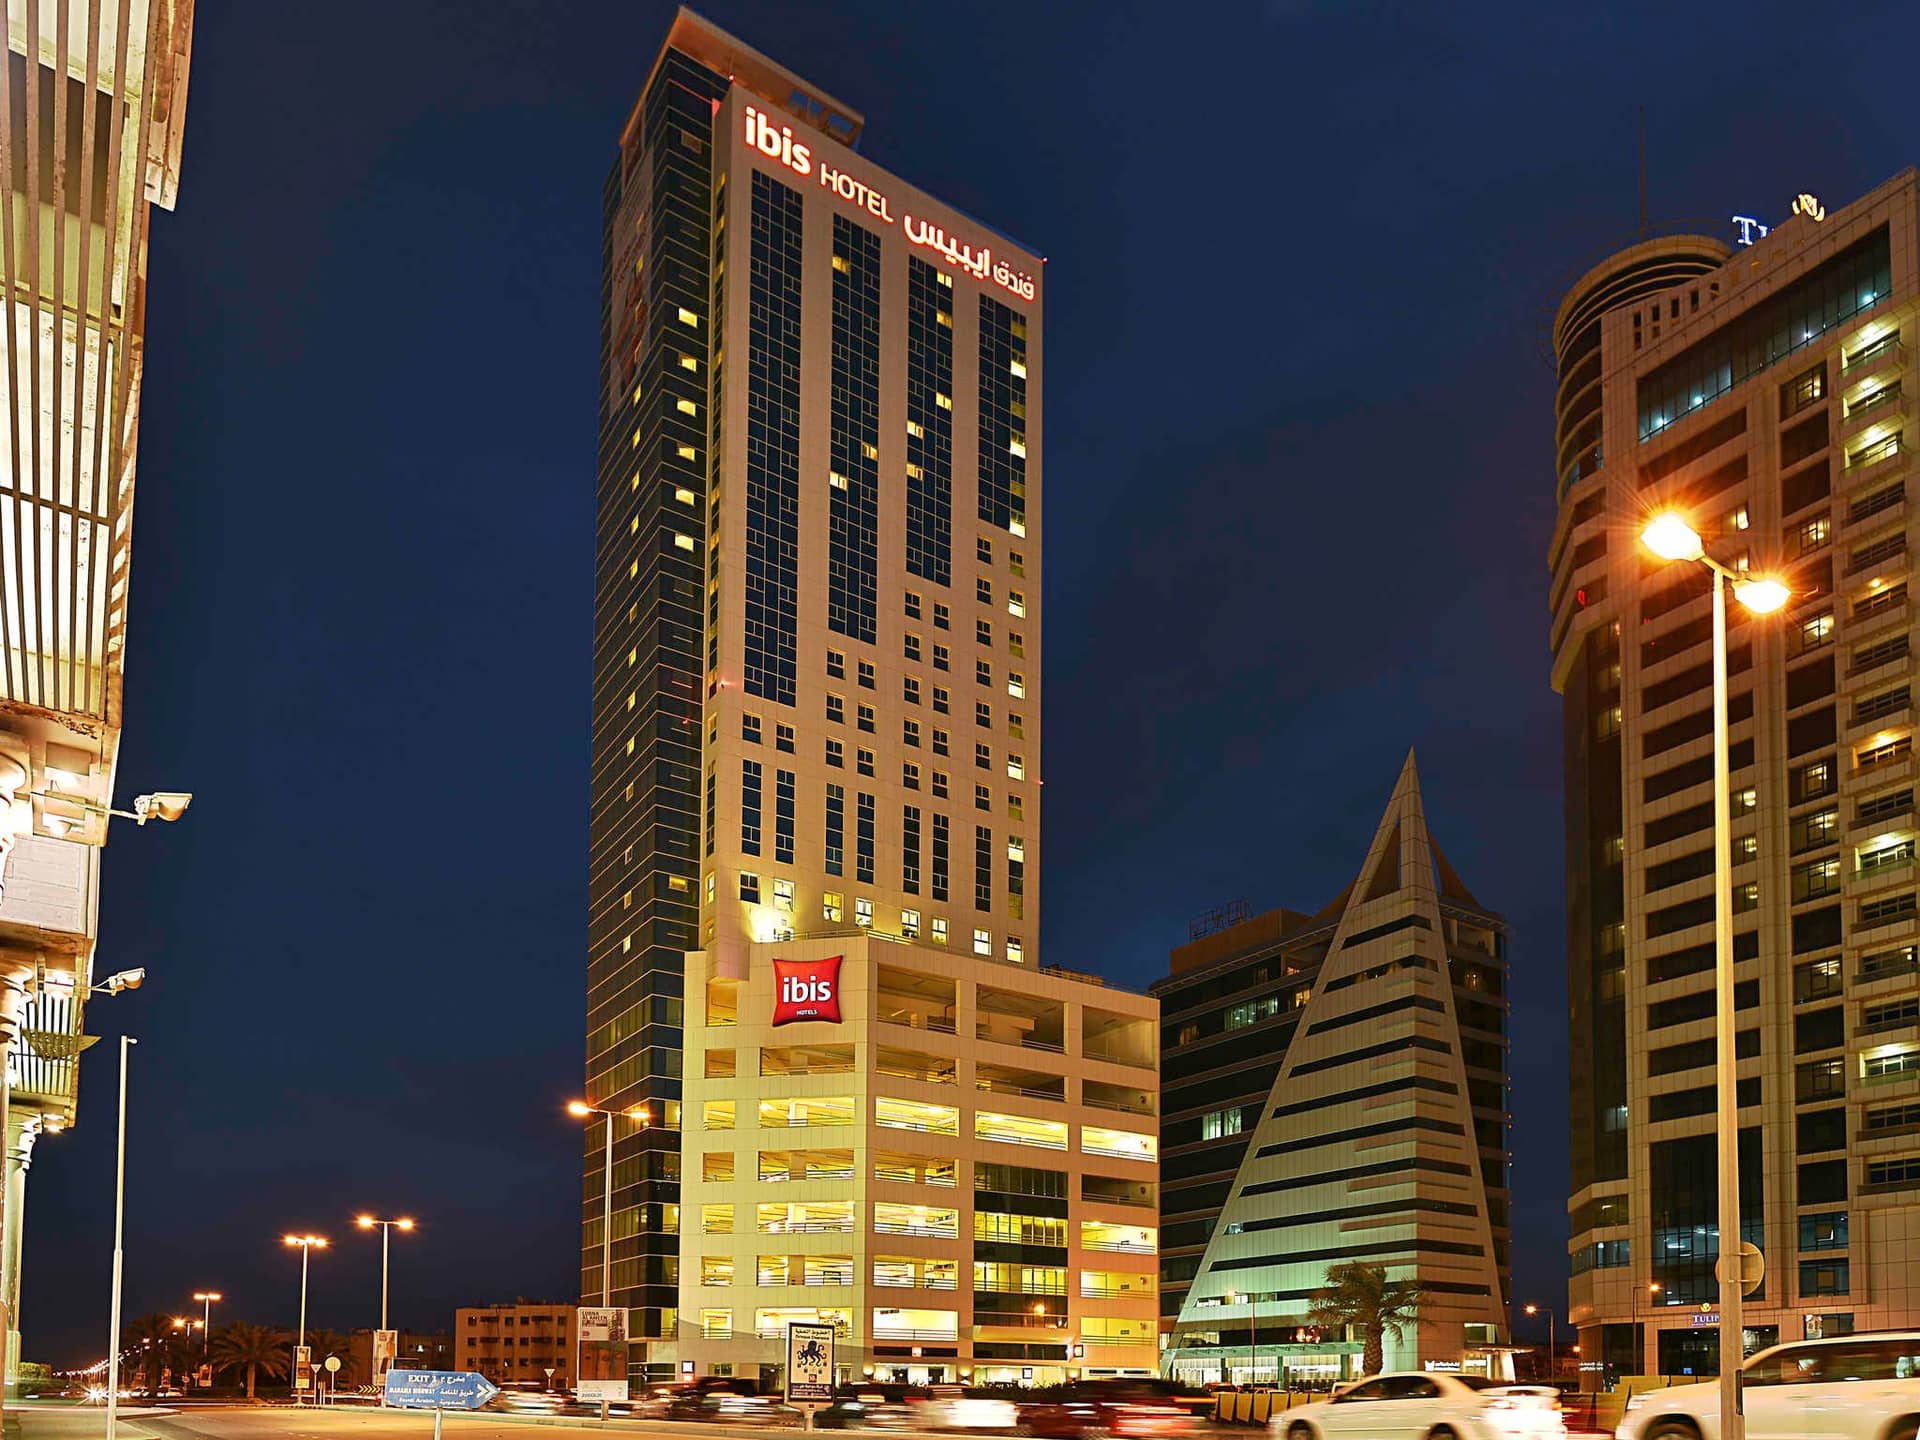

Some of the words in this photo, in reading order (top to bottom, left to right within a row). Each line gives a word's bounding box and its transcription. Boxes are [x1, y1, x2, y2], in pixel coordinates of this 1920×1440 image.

[745, 106, 811, 175] ibis
[820, 163, 894, 223] HOTEL
[993, 260, 1036, 301] فندق
[783, 975, 832, 1003] ibis
[1692, 1314, 1720, 1323] TULIP
[408, 1375, 430, 1383] EXIT
